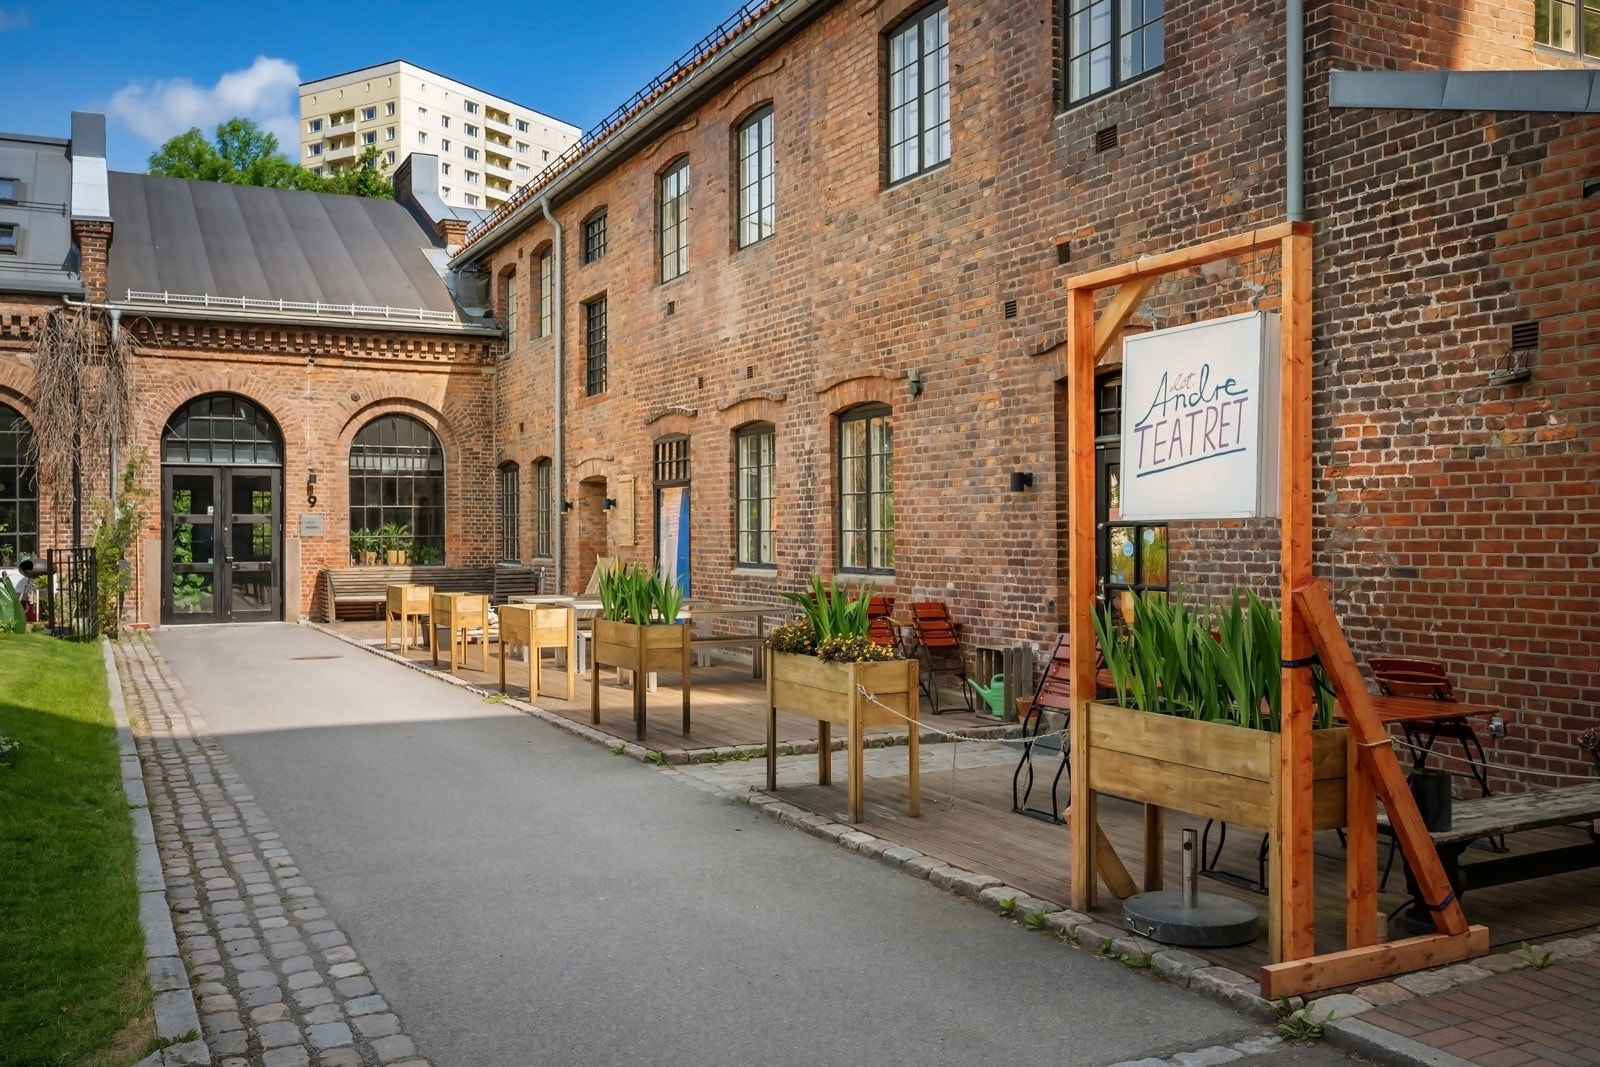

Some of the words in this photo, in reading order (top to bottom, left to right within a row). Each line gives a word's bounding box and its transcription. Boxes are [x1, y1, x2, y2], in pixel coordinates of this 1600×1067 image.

[1135, 363, 1248, 427] Andre
[1169, 372, 1196, 392] det
[1134, 397, 1248, 469] TEATRET
[307, 495, 317, 508] 9
